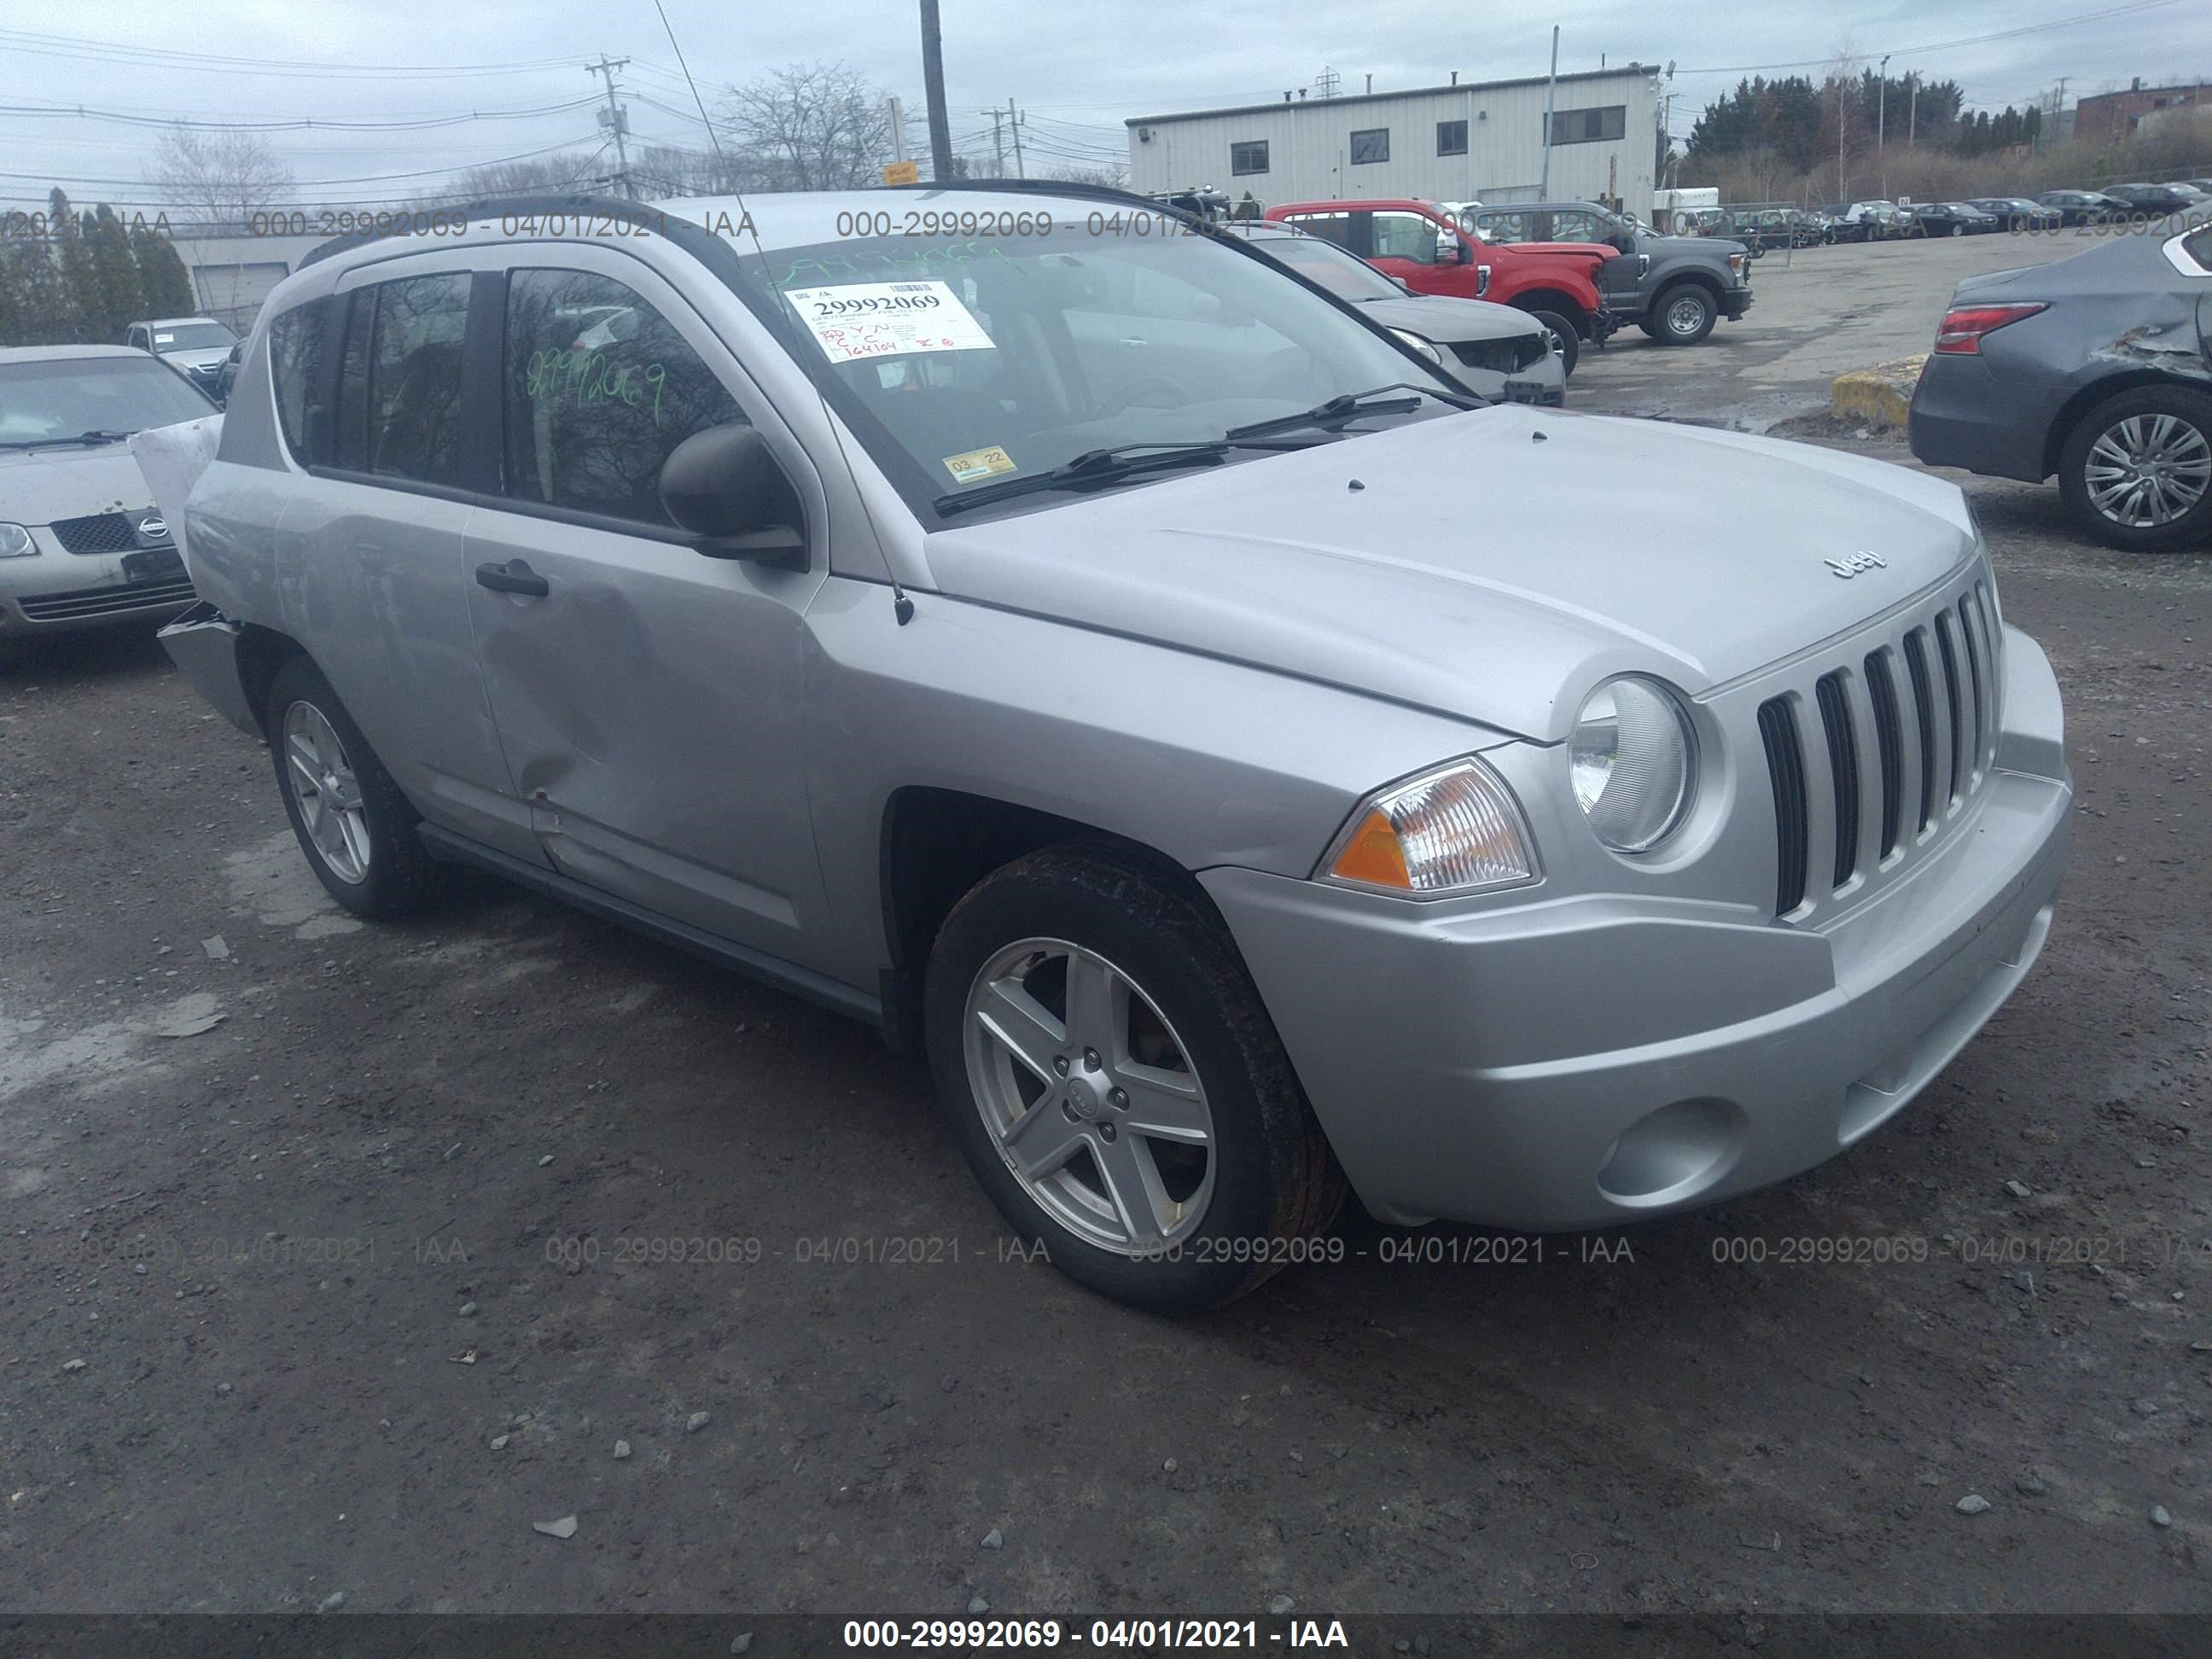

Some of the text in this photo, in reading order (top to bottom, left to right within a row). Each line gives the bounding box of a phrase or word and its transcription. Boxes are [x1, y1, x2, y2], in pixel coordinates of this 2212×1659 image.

[813, 294, 940, 315] 29992069
[845, 342, 897, 357] 164104
[952, 451, 1004, 472] 03 22
[1823, 550, 1888, 579] Jeep
